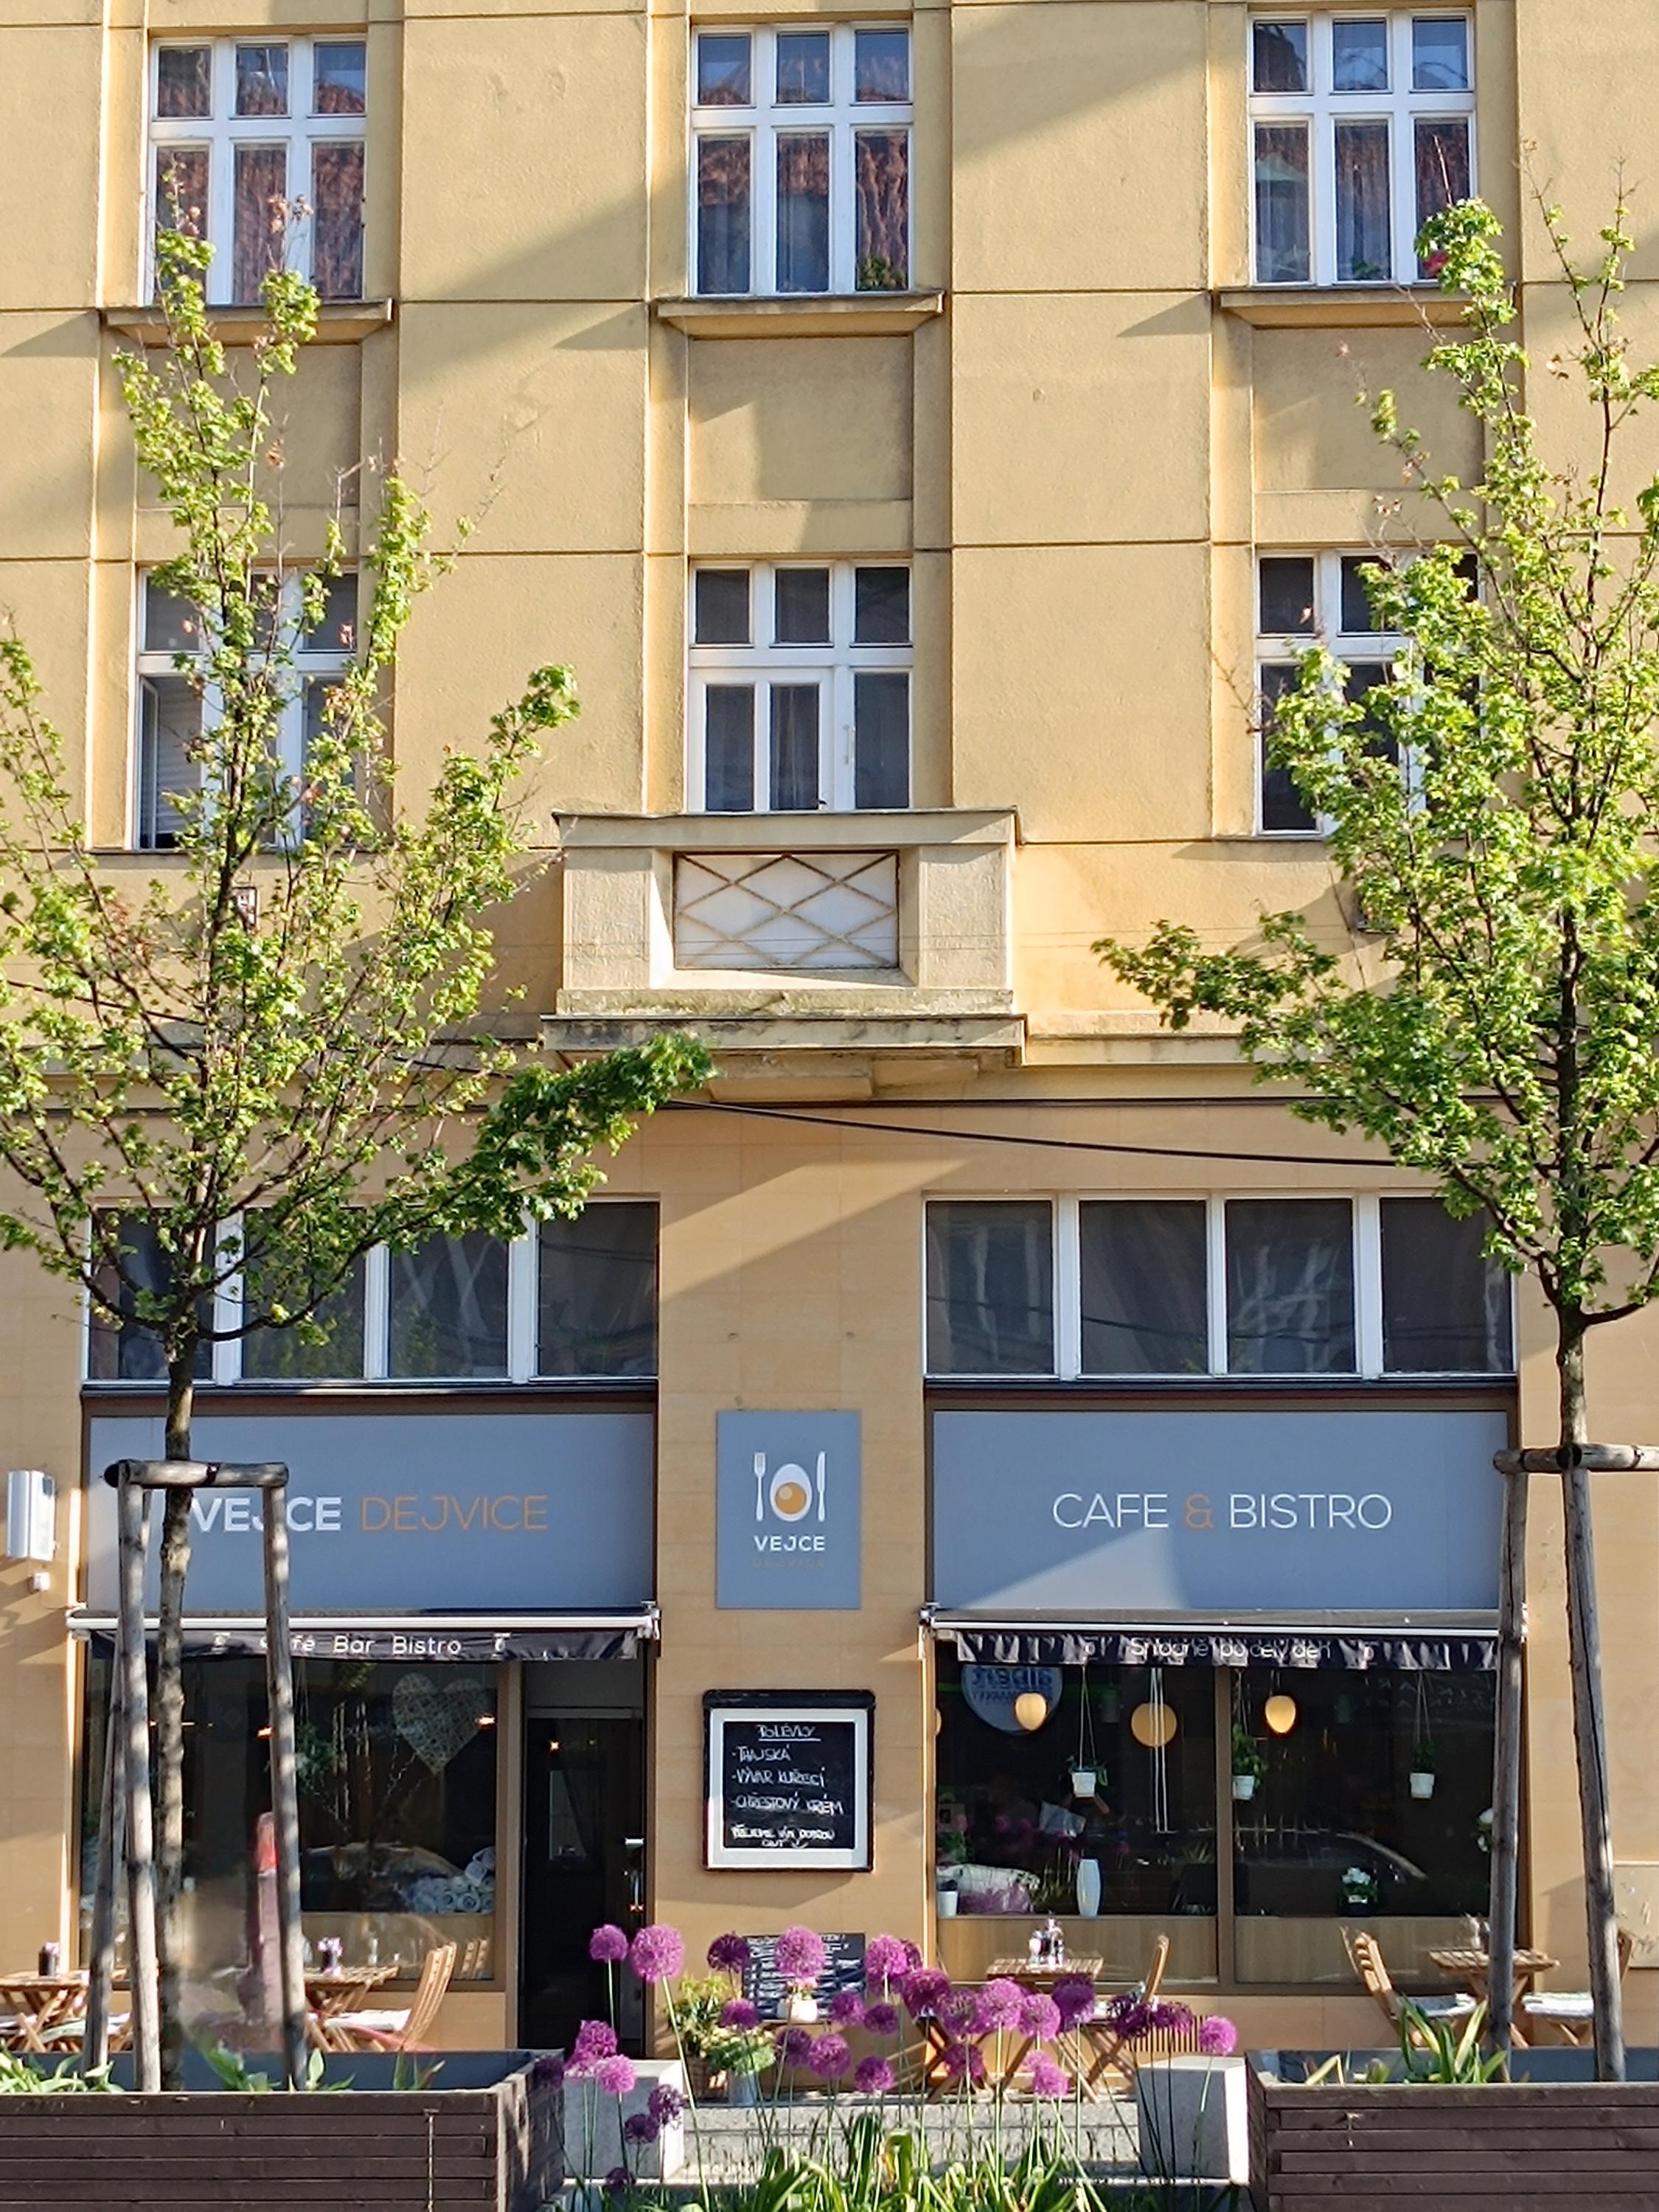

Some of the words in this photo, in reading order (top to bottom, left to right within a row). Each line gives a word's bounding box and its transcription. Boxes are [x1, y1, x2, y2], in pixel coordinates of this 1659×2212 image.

[190, 1497, 342, 1532] VECE
[361, 1495, 549, 1531] DEJVICE
[1052, 1492, 1169, 1530] CAFE
[1183, 1492, 1214, 1531] &
[1228, 1492, 1393, 1530] BISTRO
[753, 1535, 826, 1552] VEJCE
[260, 1631, 316, 1652] Cfé
[333, 1635, 374, 1654] Bar
[392, 1635, 462, 1655] Bistro
